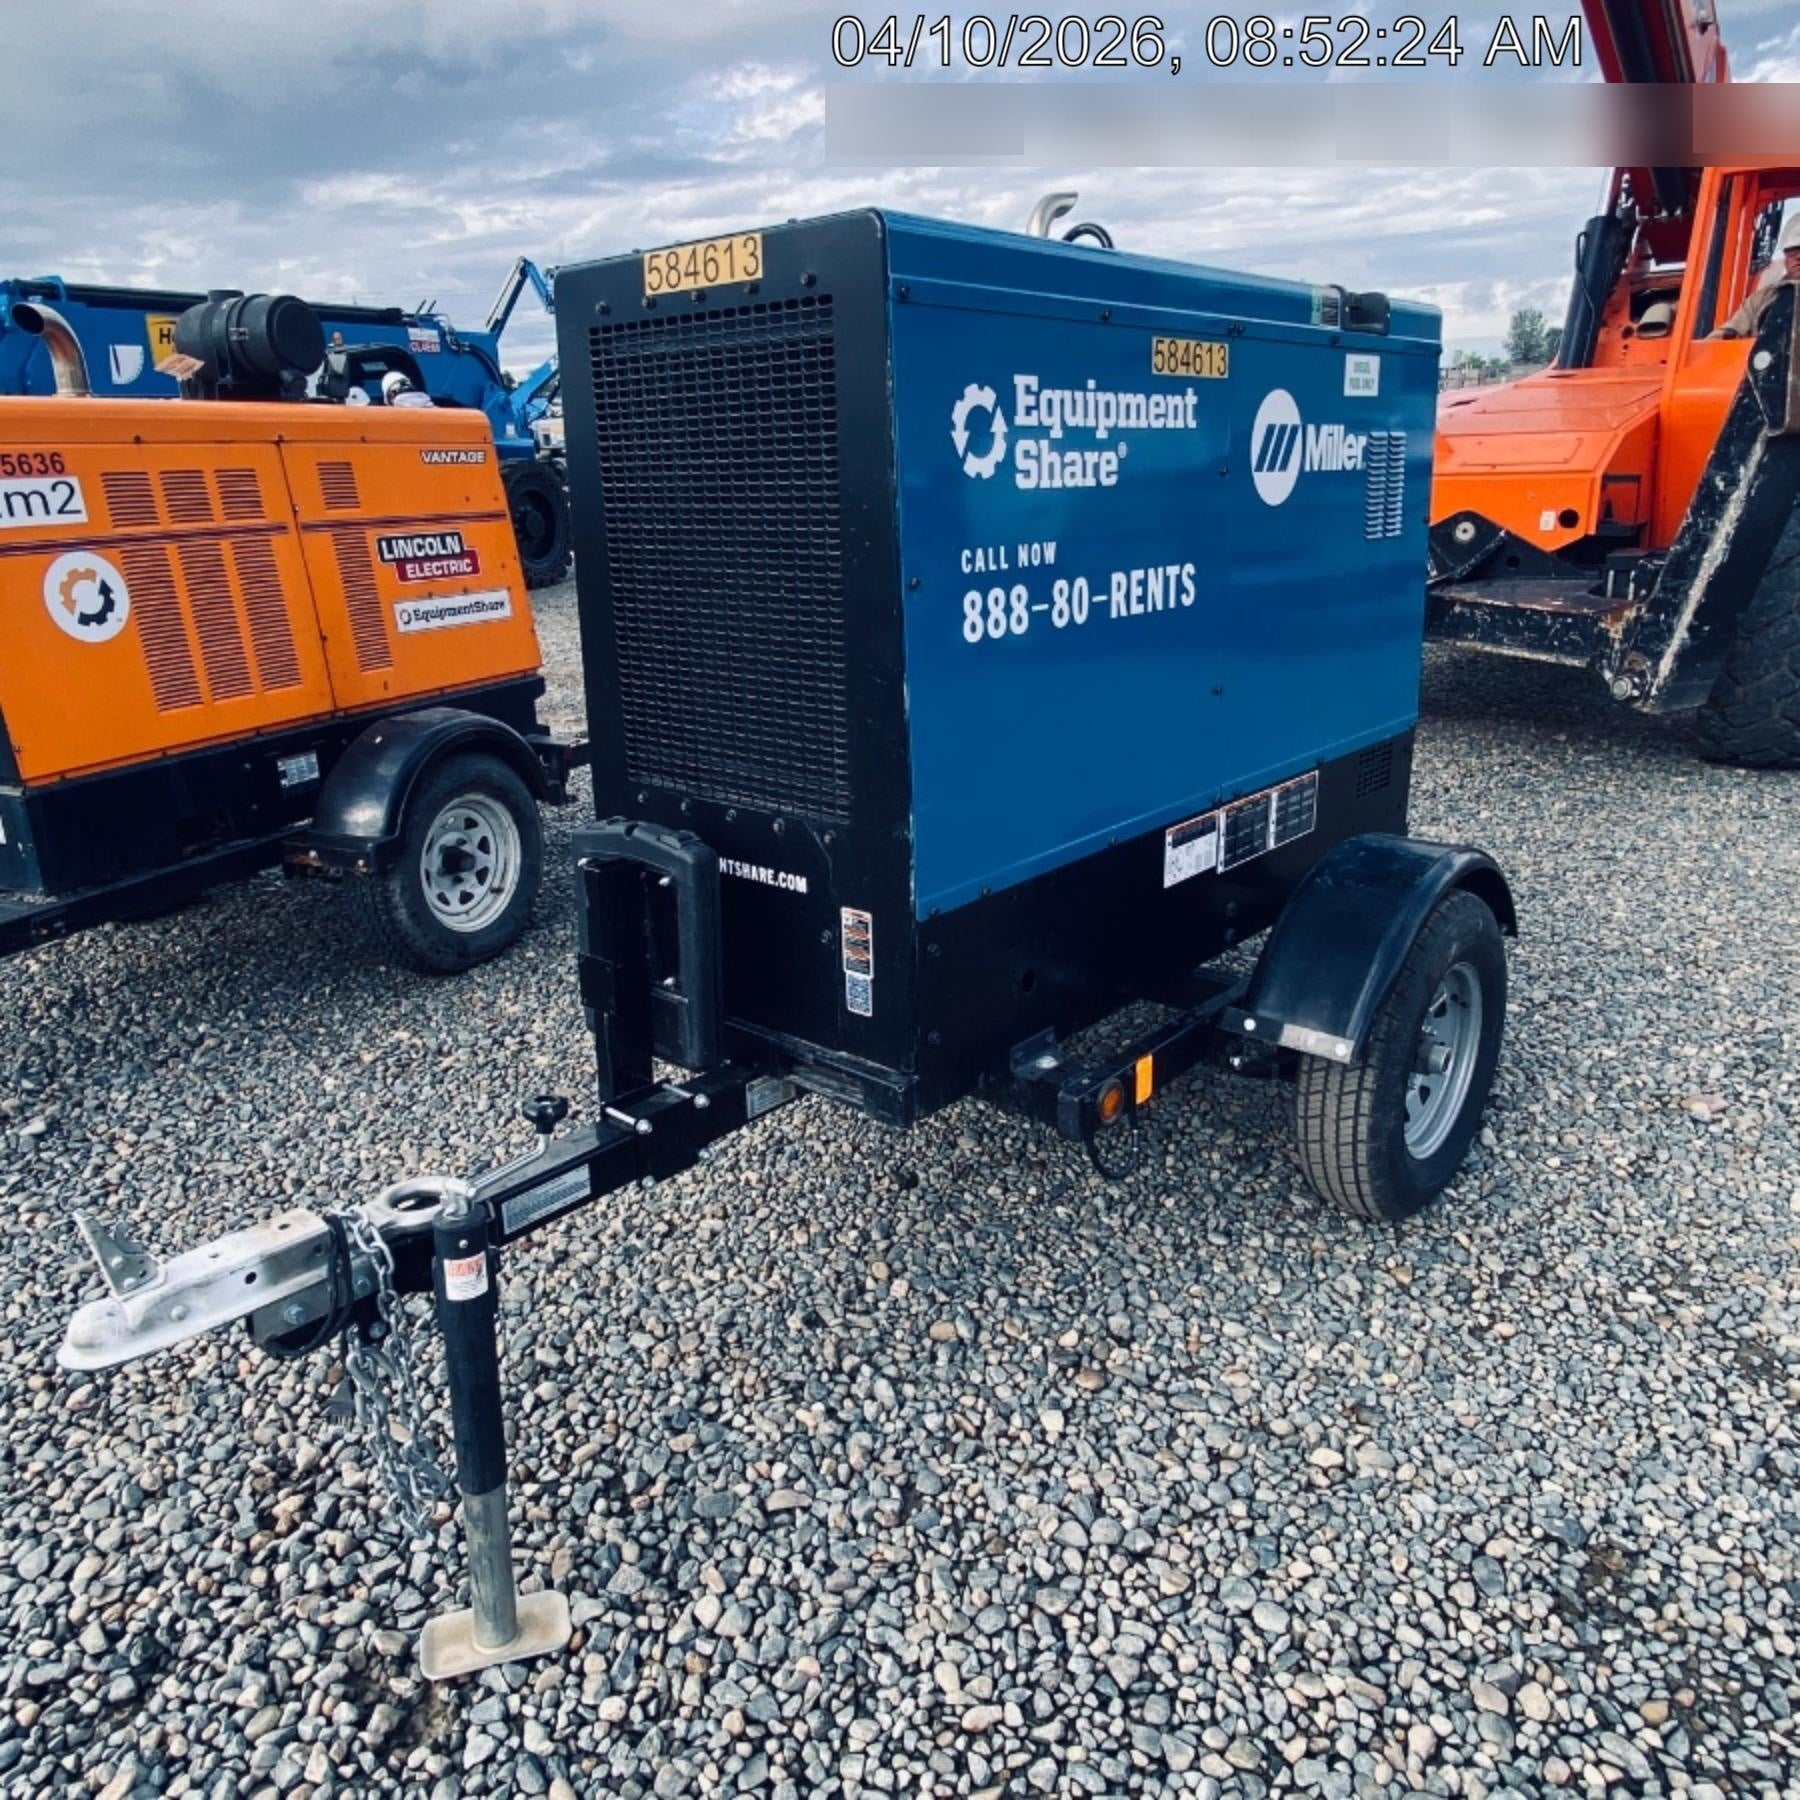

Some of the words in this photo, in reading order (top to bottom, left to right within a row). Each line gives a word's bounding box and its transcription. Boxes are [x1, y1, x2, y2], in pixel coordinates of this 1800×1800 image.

[646, 235, 759, 292] 584613
[1154, 339, 1227, 377] 584613
[1013, 374, 1197, 438] Equipment
[421, 451, 486, 464] VANTAGE
[1304, 423, 1367, 472] Miller
[0, 480, 82, 518] m2
[380, 535, 461, 561] LINCOLN
[961, 546, 1008, 574] CALL
[1017, 541, 1057, 567] NOW
[405, 558, 473, 579] ELECTRIC
[413, 601, 505, 622] EquipmentShare
[962, 563, 1197, 643] 888-80-RENTS
